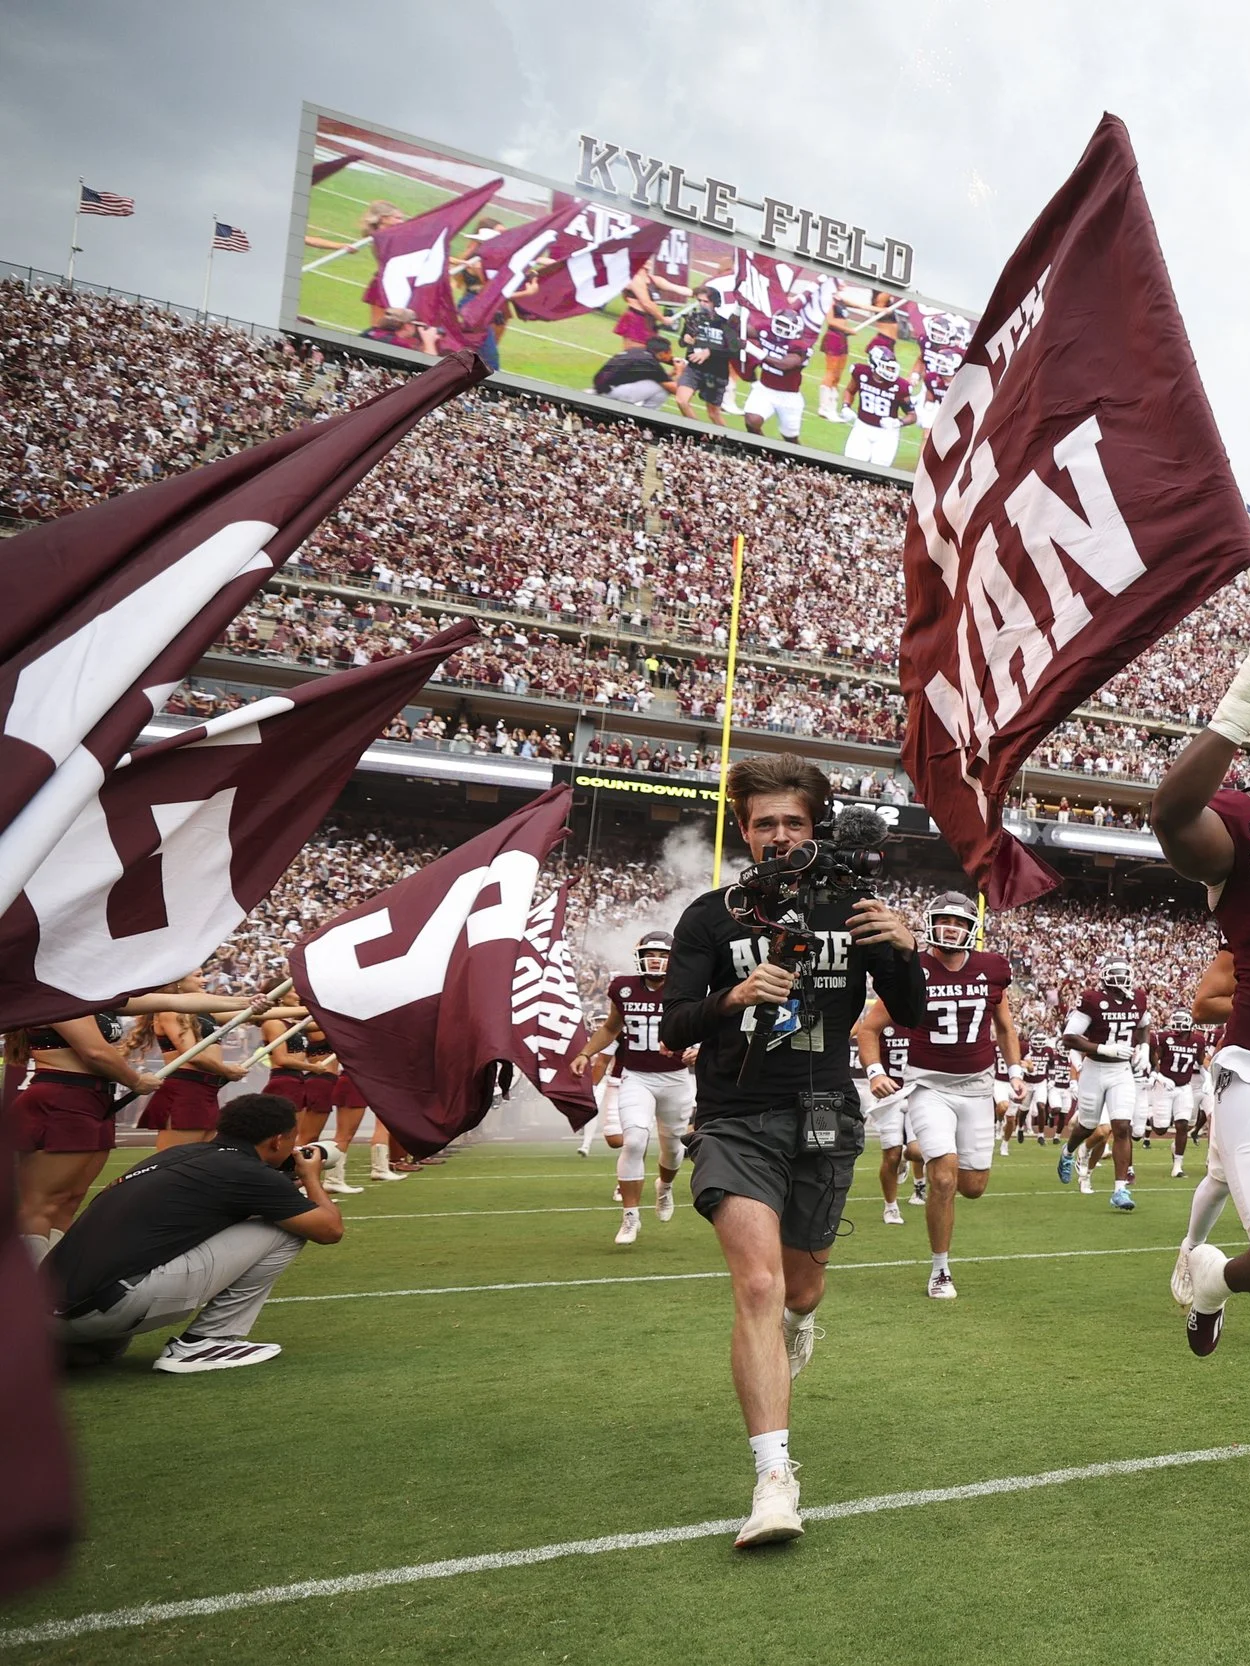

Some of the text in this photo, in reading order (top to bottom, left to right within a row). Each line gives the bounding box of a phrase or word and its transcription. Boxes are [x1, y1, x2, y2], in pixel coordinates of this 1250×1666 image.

[575, 134, 914, 288] KYLE FIELD
[860, 391, 891, 417] 88
[925, 414, 1147, 826] MAN
[576, 775, 697, 799] COUNTDOWN
[730, 931, 853, 979] AIE
[967, 985, 989, 996] A&M
[623, 1002, 656, 1012] TEXAS
[1102, 1012, 1126, 1020] TEXAS
[927, 998, 987, 1044] 37
[886, 1038, 910, 1047] TEXA
[1106, 1021, 1137, 1048] 15
[1169, 1045, 1186, 1053] TEXAS
[1170, 1053, 1194, 1073] 17
[125, 1164, 158, 1179] SONY
